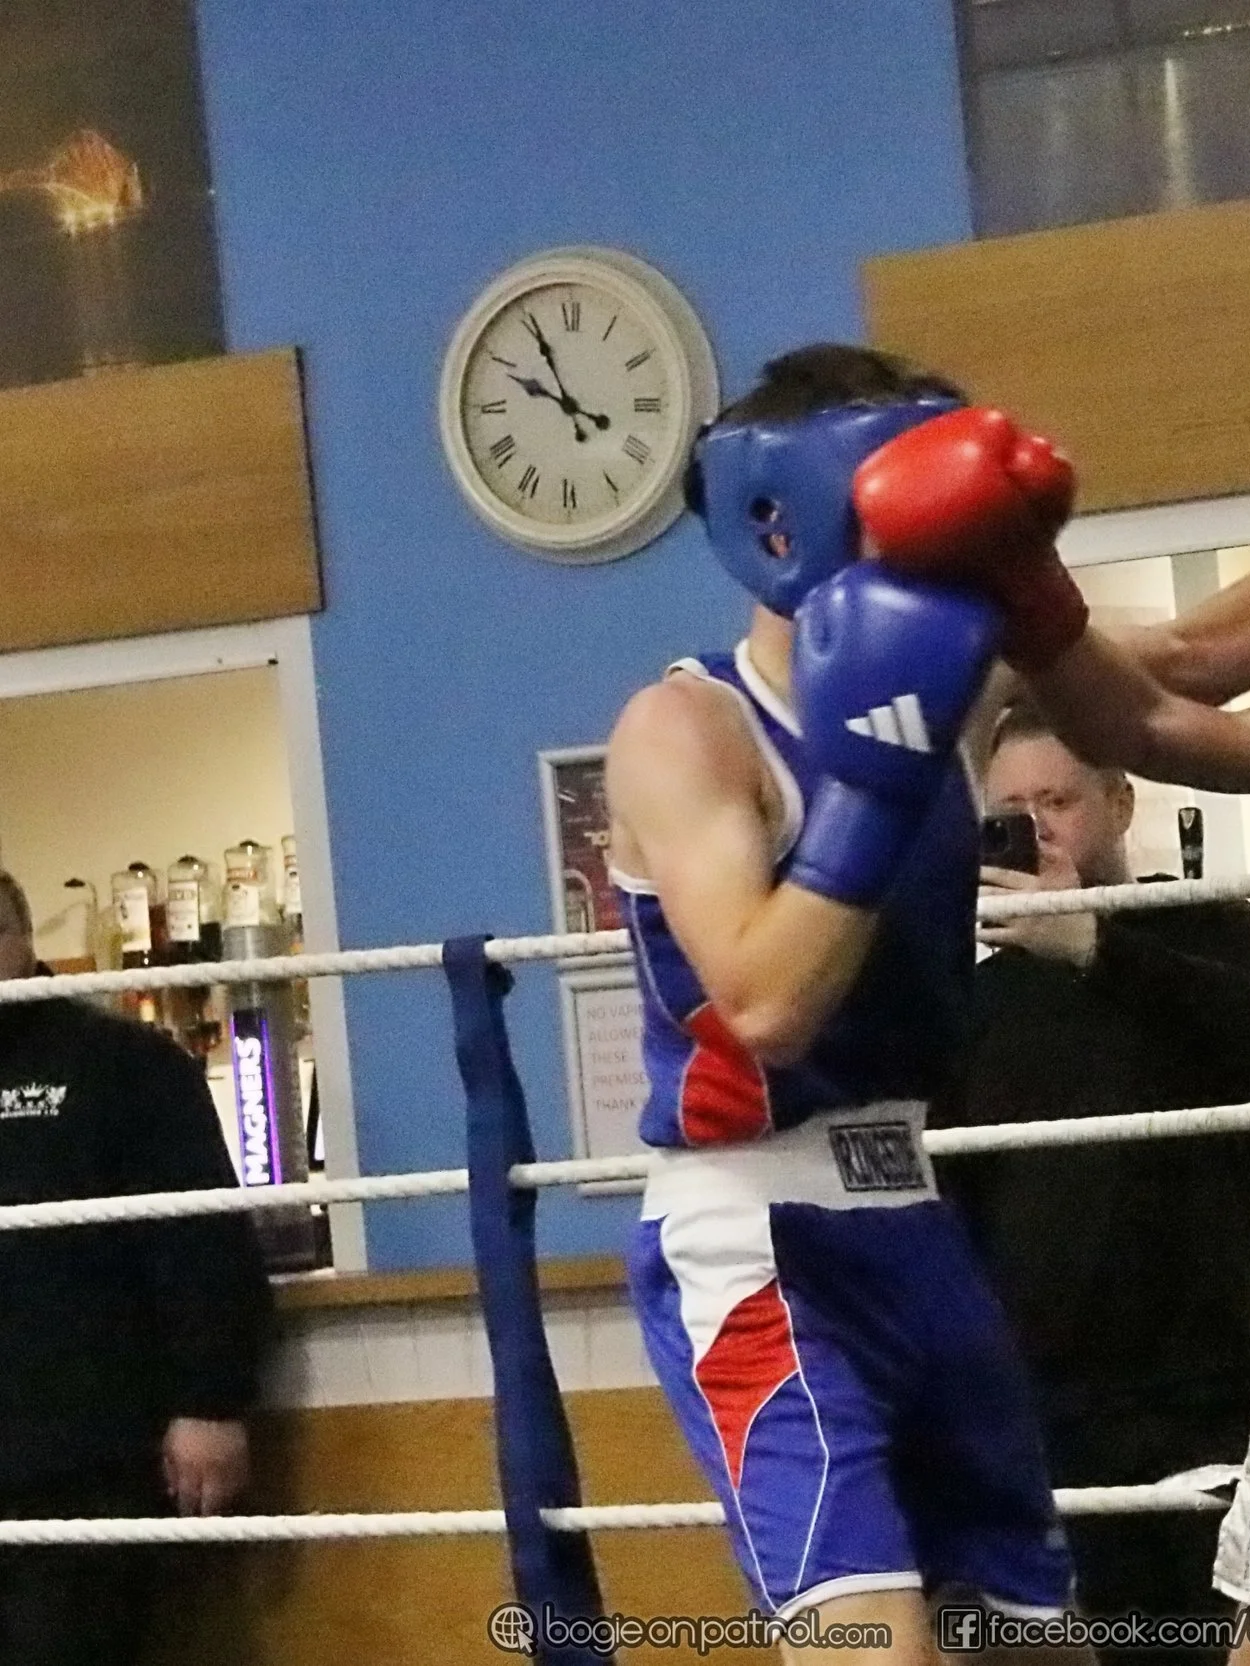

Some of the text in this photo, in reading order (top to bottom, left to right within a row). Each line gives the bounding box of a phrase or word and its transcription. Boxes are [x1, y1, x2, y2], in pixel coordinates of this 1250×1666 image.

[610, 1003, 643, 1018] VAPI
[588, 1026, 643, 1042] ALLOWE
[593, 1071, 646, 1088] PREMISE
[234, 1036, 270, 1184] MAGNERS
